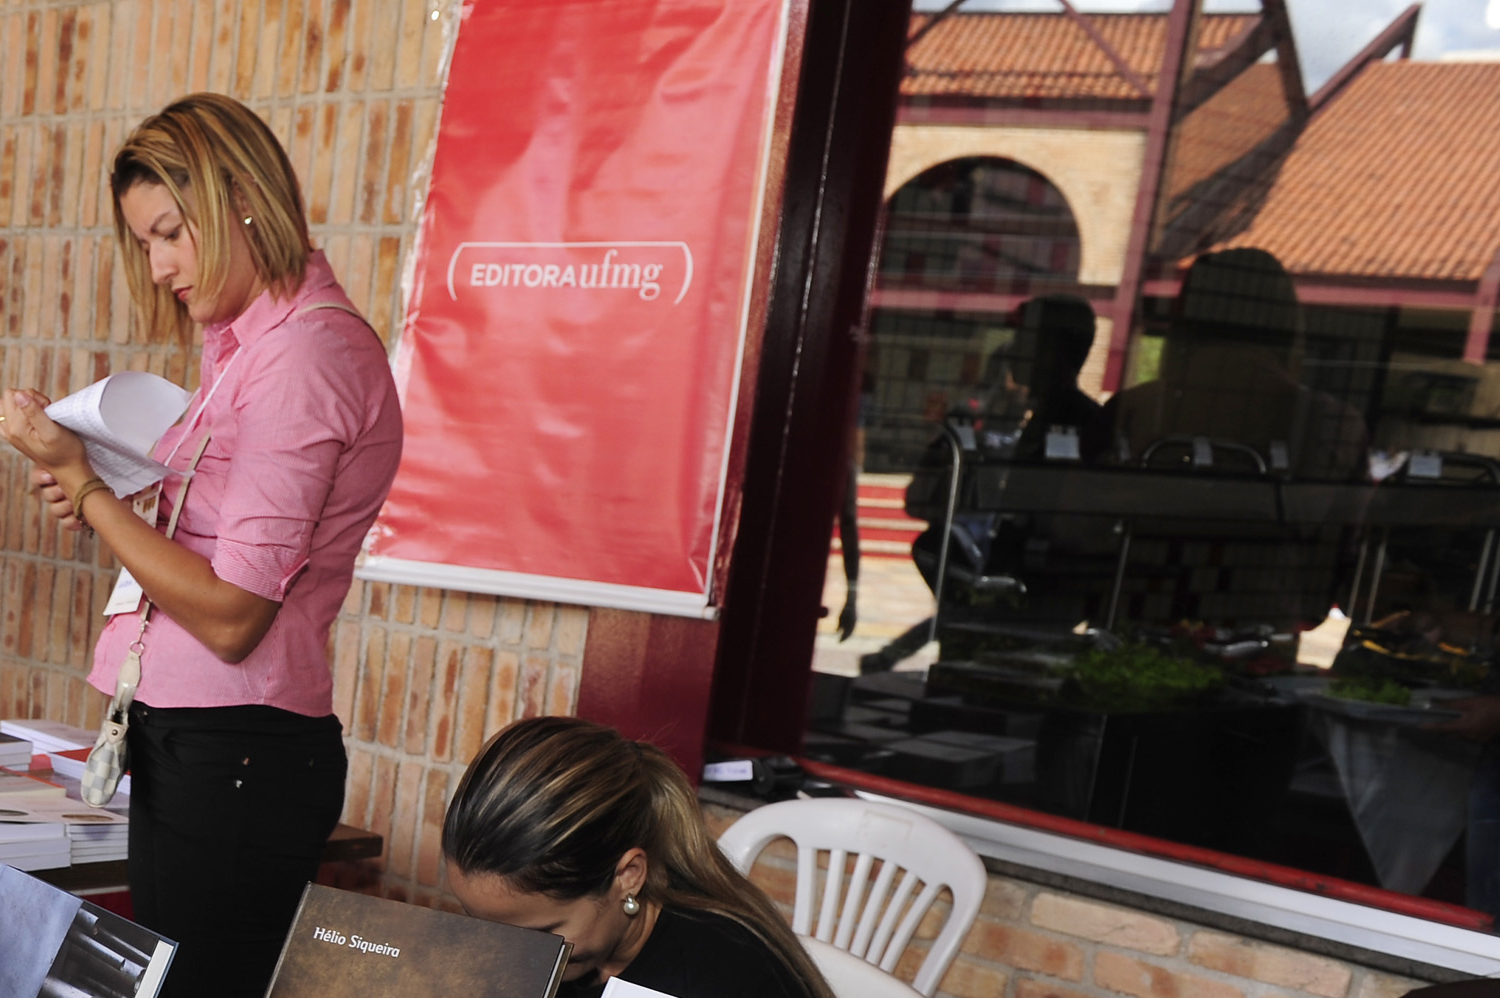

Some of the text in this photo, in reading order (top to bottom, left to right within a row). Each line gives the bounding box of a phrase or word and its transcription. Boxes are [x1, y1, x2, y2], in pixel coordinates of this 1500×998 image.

[470, 249, 663, 301] EDITORA ufmg
[313, 926, 400, 958] Hélio Siqueira
